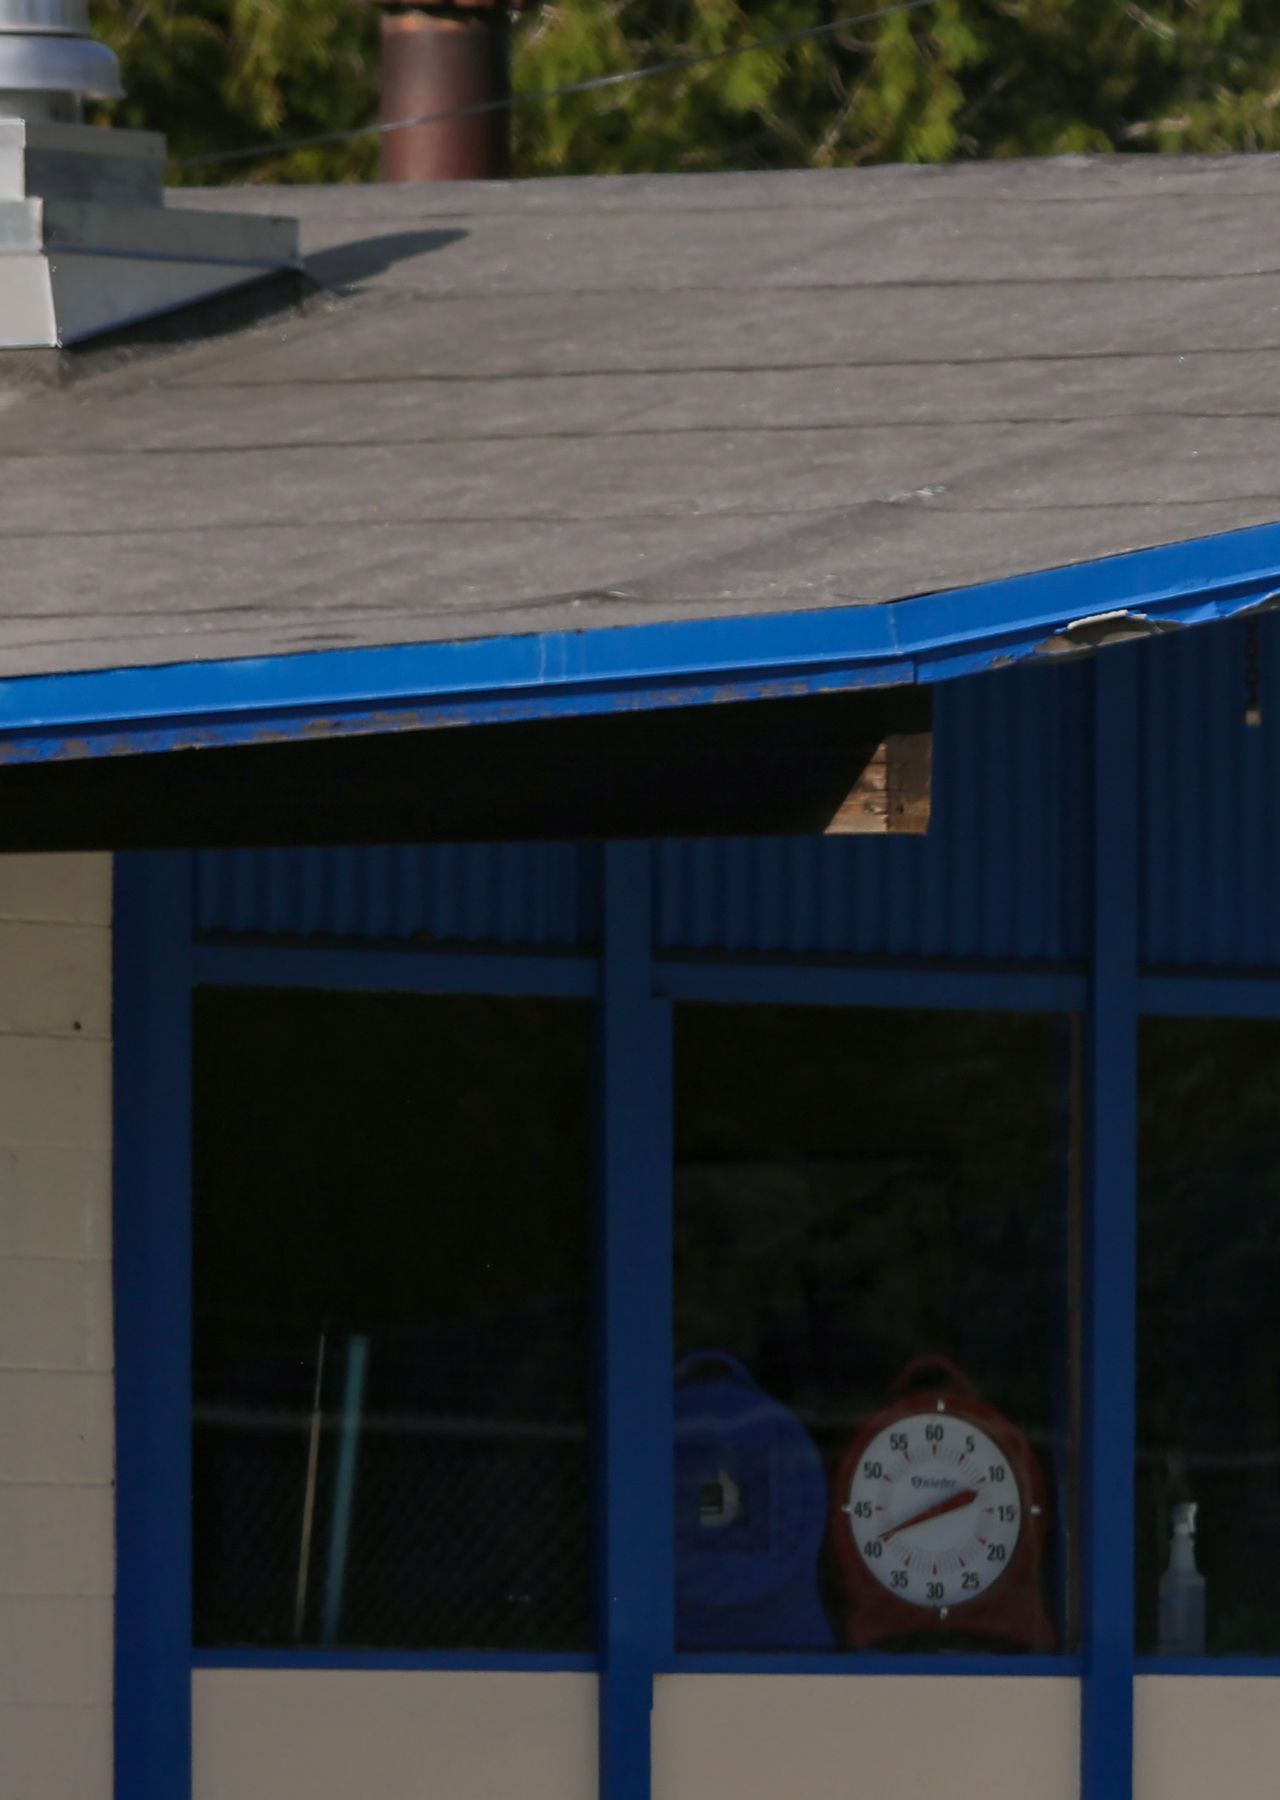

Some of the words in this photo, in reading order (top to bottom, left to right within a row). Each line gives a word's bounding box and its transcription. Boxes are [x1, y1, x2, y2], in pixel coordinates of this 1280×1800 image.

[925, 1424, 944, 1441] 60
[890, 1434, 908, 1450] 55
[966, 1436, 975, 1453] 5
[864, 1462, 882, 1479] 50
[989, 1466, 1004, 1482] 10
[854, 1501, 872, 1518] 45
[998, 1505, 1015, 1522] 15
[864, 1541, 882, 1558] 40
[988, 1544, 1005, 1560] 20
[890, 1571, 908, 1588] 35
[962, 1573, 979, 1589] 25
[926, 1582, 944, 1599] 30
